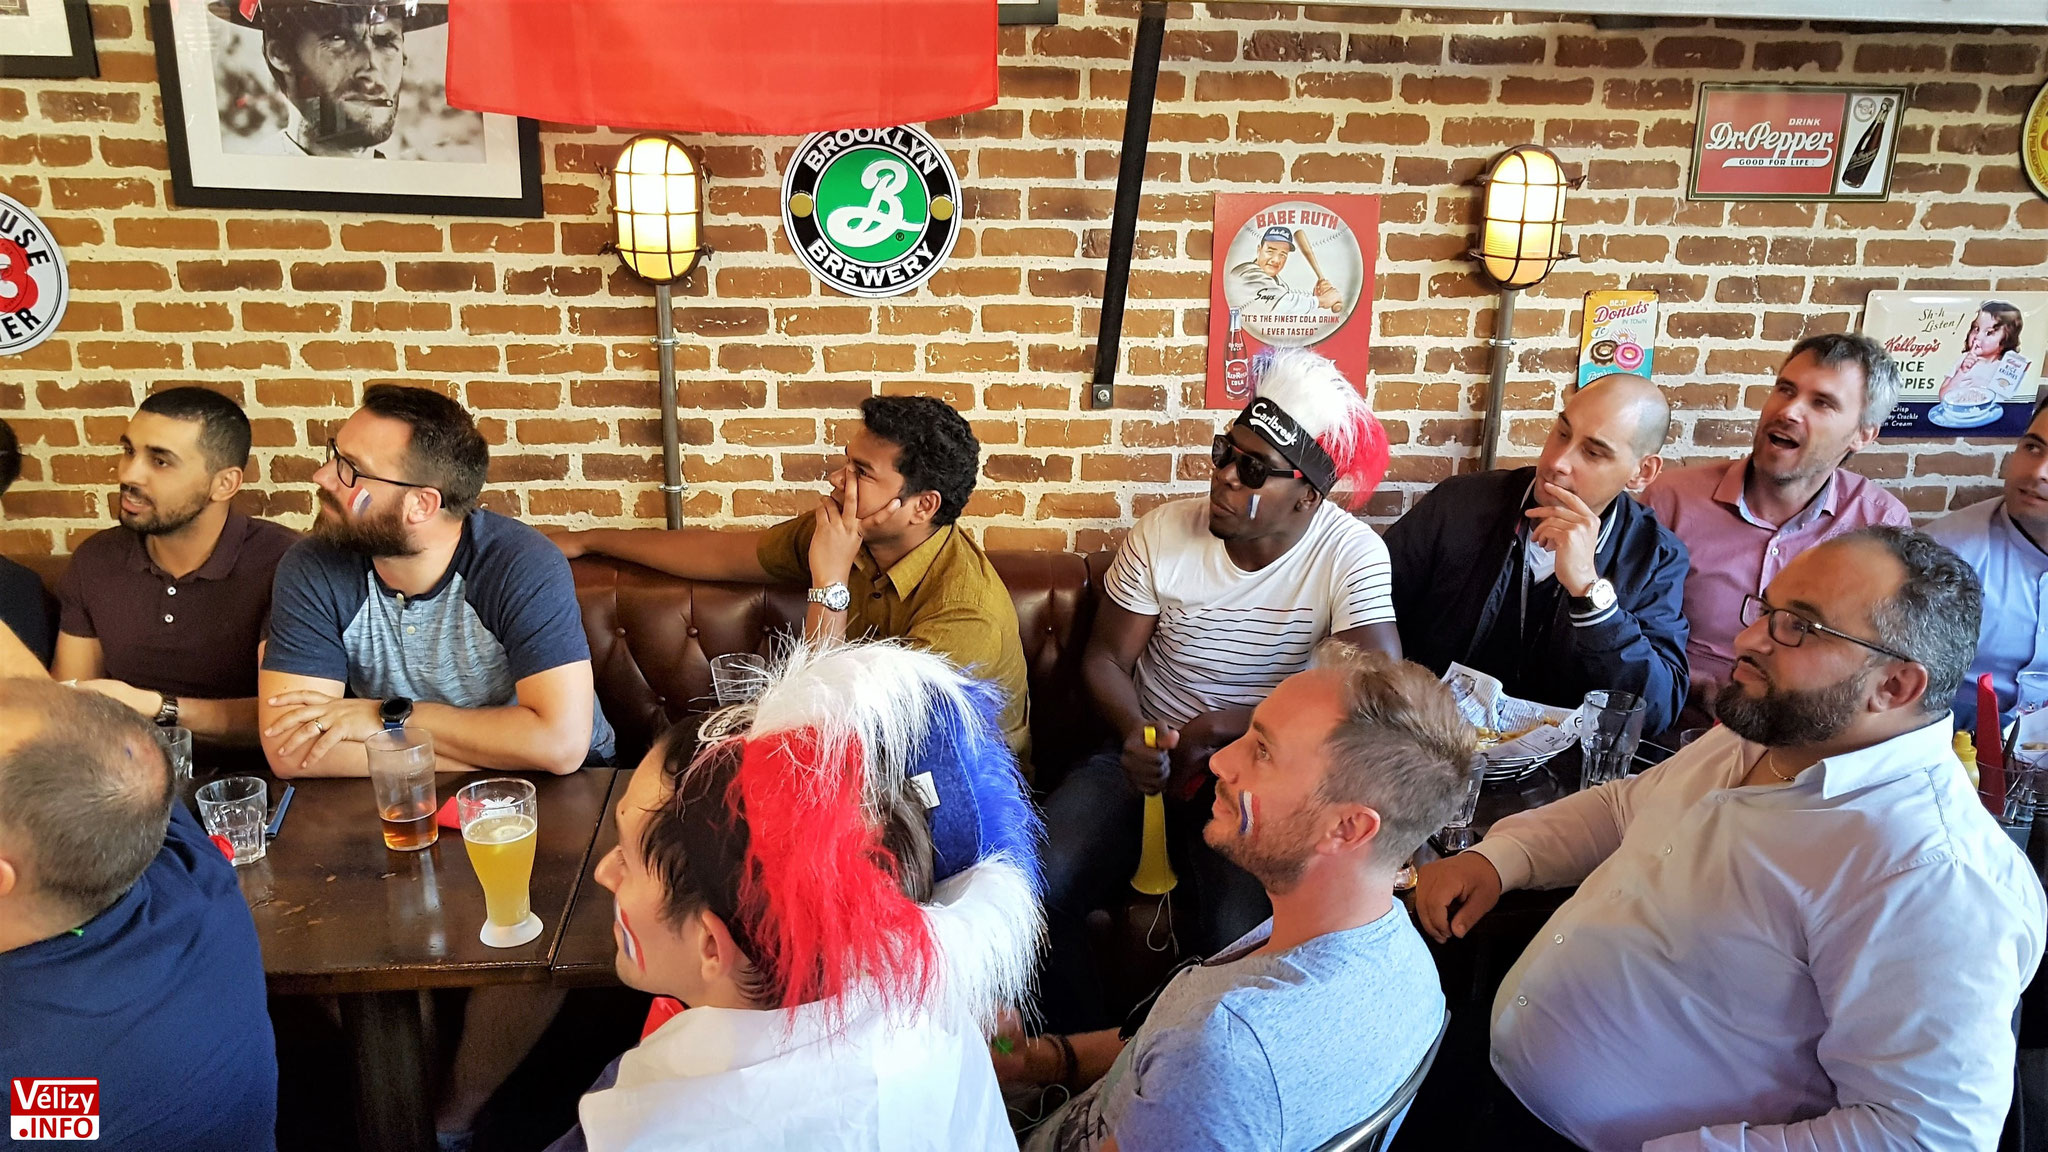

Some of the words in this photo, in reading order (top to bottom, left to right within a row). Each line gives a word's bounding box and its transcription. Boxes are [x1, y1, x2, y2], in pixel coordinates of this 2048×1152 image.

[1788, 118, 1821, 126] DRINK
[804, 127, 939, 176] BROOKLYN
[1256, 210, 1296, 229] BABE
[1300, 210, 1339, 231] RUTH
[807, 238, 935, 287] BREWERY
[1254, 288, 1276, 304] Says
[1260, 314, 1273, 323] THE
[1275, 314, 1298, 323] FINEST
[1300, 314, 1317, 323] COLA
[1320, 314, 1340, 323] DRINK
[1592, 301, 1650, 323] Donuts
[1918, 307, 1945, 321] Sh-h
[0, 307, 42, 342] ER
[1267, 328, 1285, 336] EVER
[1884, 335, 1941, 357] Kellogg's
[1900, 377, 1935, 389] PIES
[1252, 402, 1298, 446] Carlbreak
